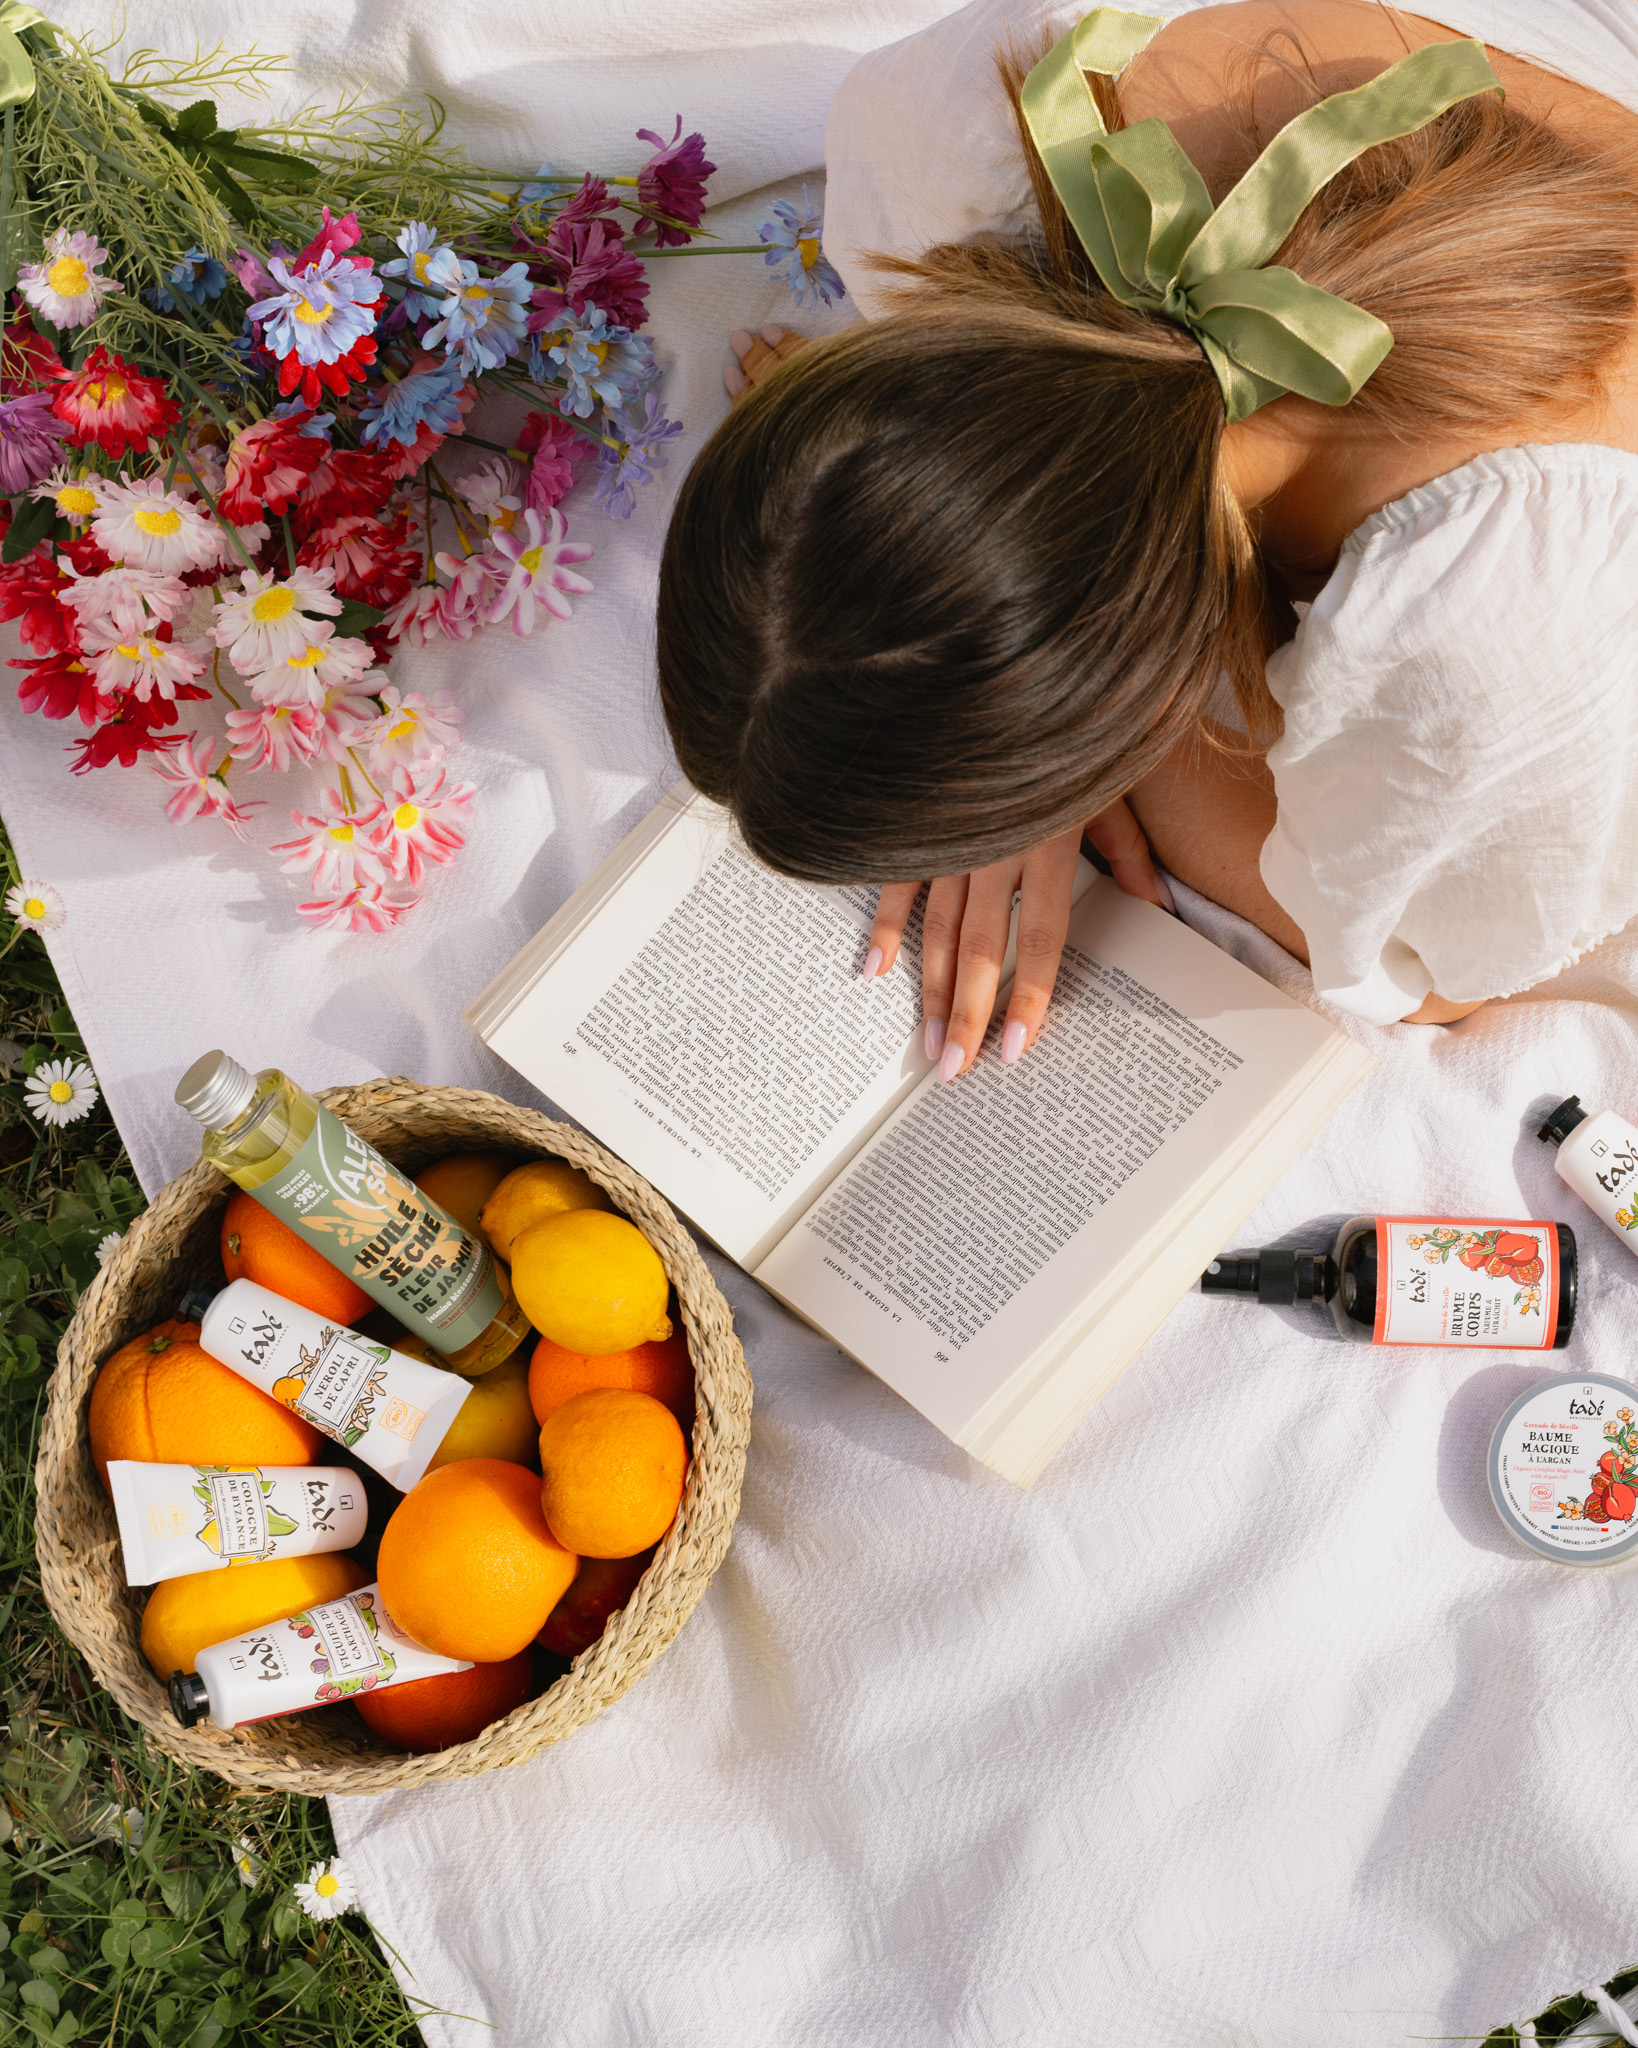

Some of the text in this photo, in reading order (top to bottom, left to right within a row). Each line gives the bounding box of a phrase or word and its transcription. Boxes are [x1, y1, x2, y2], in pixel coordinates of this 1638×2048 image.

[1128, 979, 1139, 988] ou
[1135, 983, 1156, 1000] pierre
[1082, 996, 1096, 1008] des
[1093, 1002, 1114, 1019] Pylos
[1151, 996, 1161, 1005] la
[1158, 1001, 1170, 1010] sur
[1110, 1016, 1121, 1025] et
[1117, 1020, 1135, 1035] Tyr
[1166, 1006, 1201, 1033] inscriptions
[579, 1018, 622, 1055] l'empereur
[1068, 1034, 1083, 1046] des
[1132, 1031, 1148, 1044] vers
[1196, 1029, 1209, 1040] des
[1206, 1036, 1222, 1050] dans
[561, 1040, 579, 1057] 267
[622, 966, 828, 1140] modèle du genre. Rabelais, Montaigne, Jean-Jacques Rous-
[1081, 1043, 1092, 1053] et
[1146, 1040, 1171, 1060] jusque
[1219, 1046, 1229, 1055] et
[1225, 1050, 1244, 1066] ments
[619, 1051, 638, 1069] avec
[1090, 1049, 1123, 1076] Fabricien
[1166, 1058, 1177, 1067] et
[636, 1065, 678, 1102] opposition
[1121, 1073, 1136, 1086] des
[1174, 1064, 1201, 1085] Rhodes
[1200, 1082, 1216, 1094] vers
[674, 1097, 686, 1109] en
[1134, 1082, 1176, 1115] Gandolphe,
[683, 1106, 699, 1121] fois
[1172, 1112, 1188, 1125] des
[632, 1098, 702, 1158] LE DOUBLE DUEL
[696, 1117, 720, 1139] d'une
[717, 1133, 737, 1152] plus
[365, 1142, 387, 1195] SOA
[732, 1148, 758, 1172] trouvé
[1596, 1140, 1638, 1192] tadé
[293, 1180, 324, 1208] +98%
[774, 1185, 783, 1194] il
[354, 1199, 417, 1269] HUILE
[379, 1212, 441, 1287] SÈCHE
[397, 1254, 446, 1301] FLEUR
[412, 1236, 473, 1314] DE JASMIN
[822, 1255, 903, 1322] LA GLOIRE DE L'EMPIRE
[1409, 1268, 1426, 1303] tadé
[425, 1300, 452, 1324] jasmine
[450, 1272, 474, 1301] blossom
[1442, 1310, 1448, 1318] de
[1451, 1292, 1465, 1336] BRUME
[1466, 1292, 1481, 1337] CORPS
[1483, 1305, 1492, 1334] PARFUME
[241, 1310, 283, 1365] tadé
[933, 1350, 950, 1365] 266
[314, 1353, 346, 1400] NEROLI
[322, 1355, 360, 1411] DE CAPRI
[391, 1409, 403, 1423] BIO
[1570, 1399, 1605, 1416] tadé
[1530, 1432, 1572, 1442] BAUME
[1522, 1443, 1579, 1455] MAGIQUE
[1528, 1454, 1571, 1464] À L'ARGAN
[229, 1480, 245, 1550] DE BYZANCE
[241, 1481, 257, 1546] COLOGNE
[306, 1480, 335, 1532] tadé
[317, 1609, 351, 1669] FIGUIER DE
[333, 1609, 362, 1661] CARTHAGE
[240, 1635, 282, 1681] tadé
